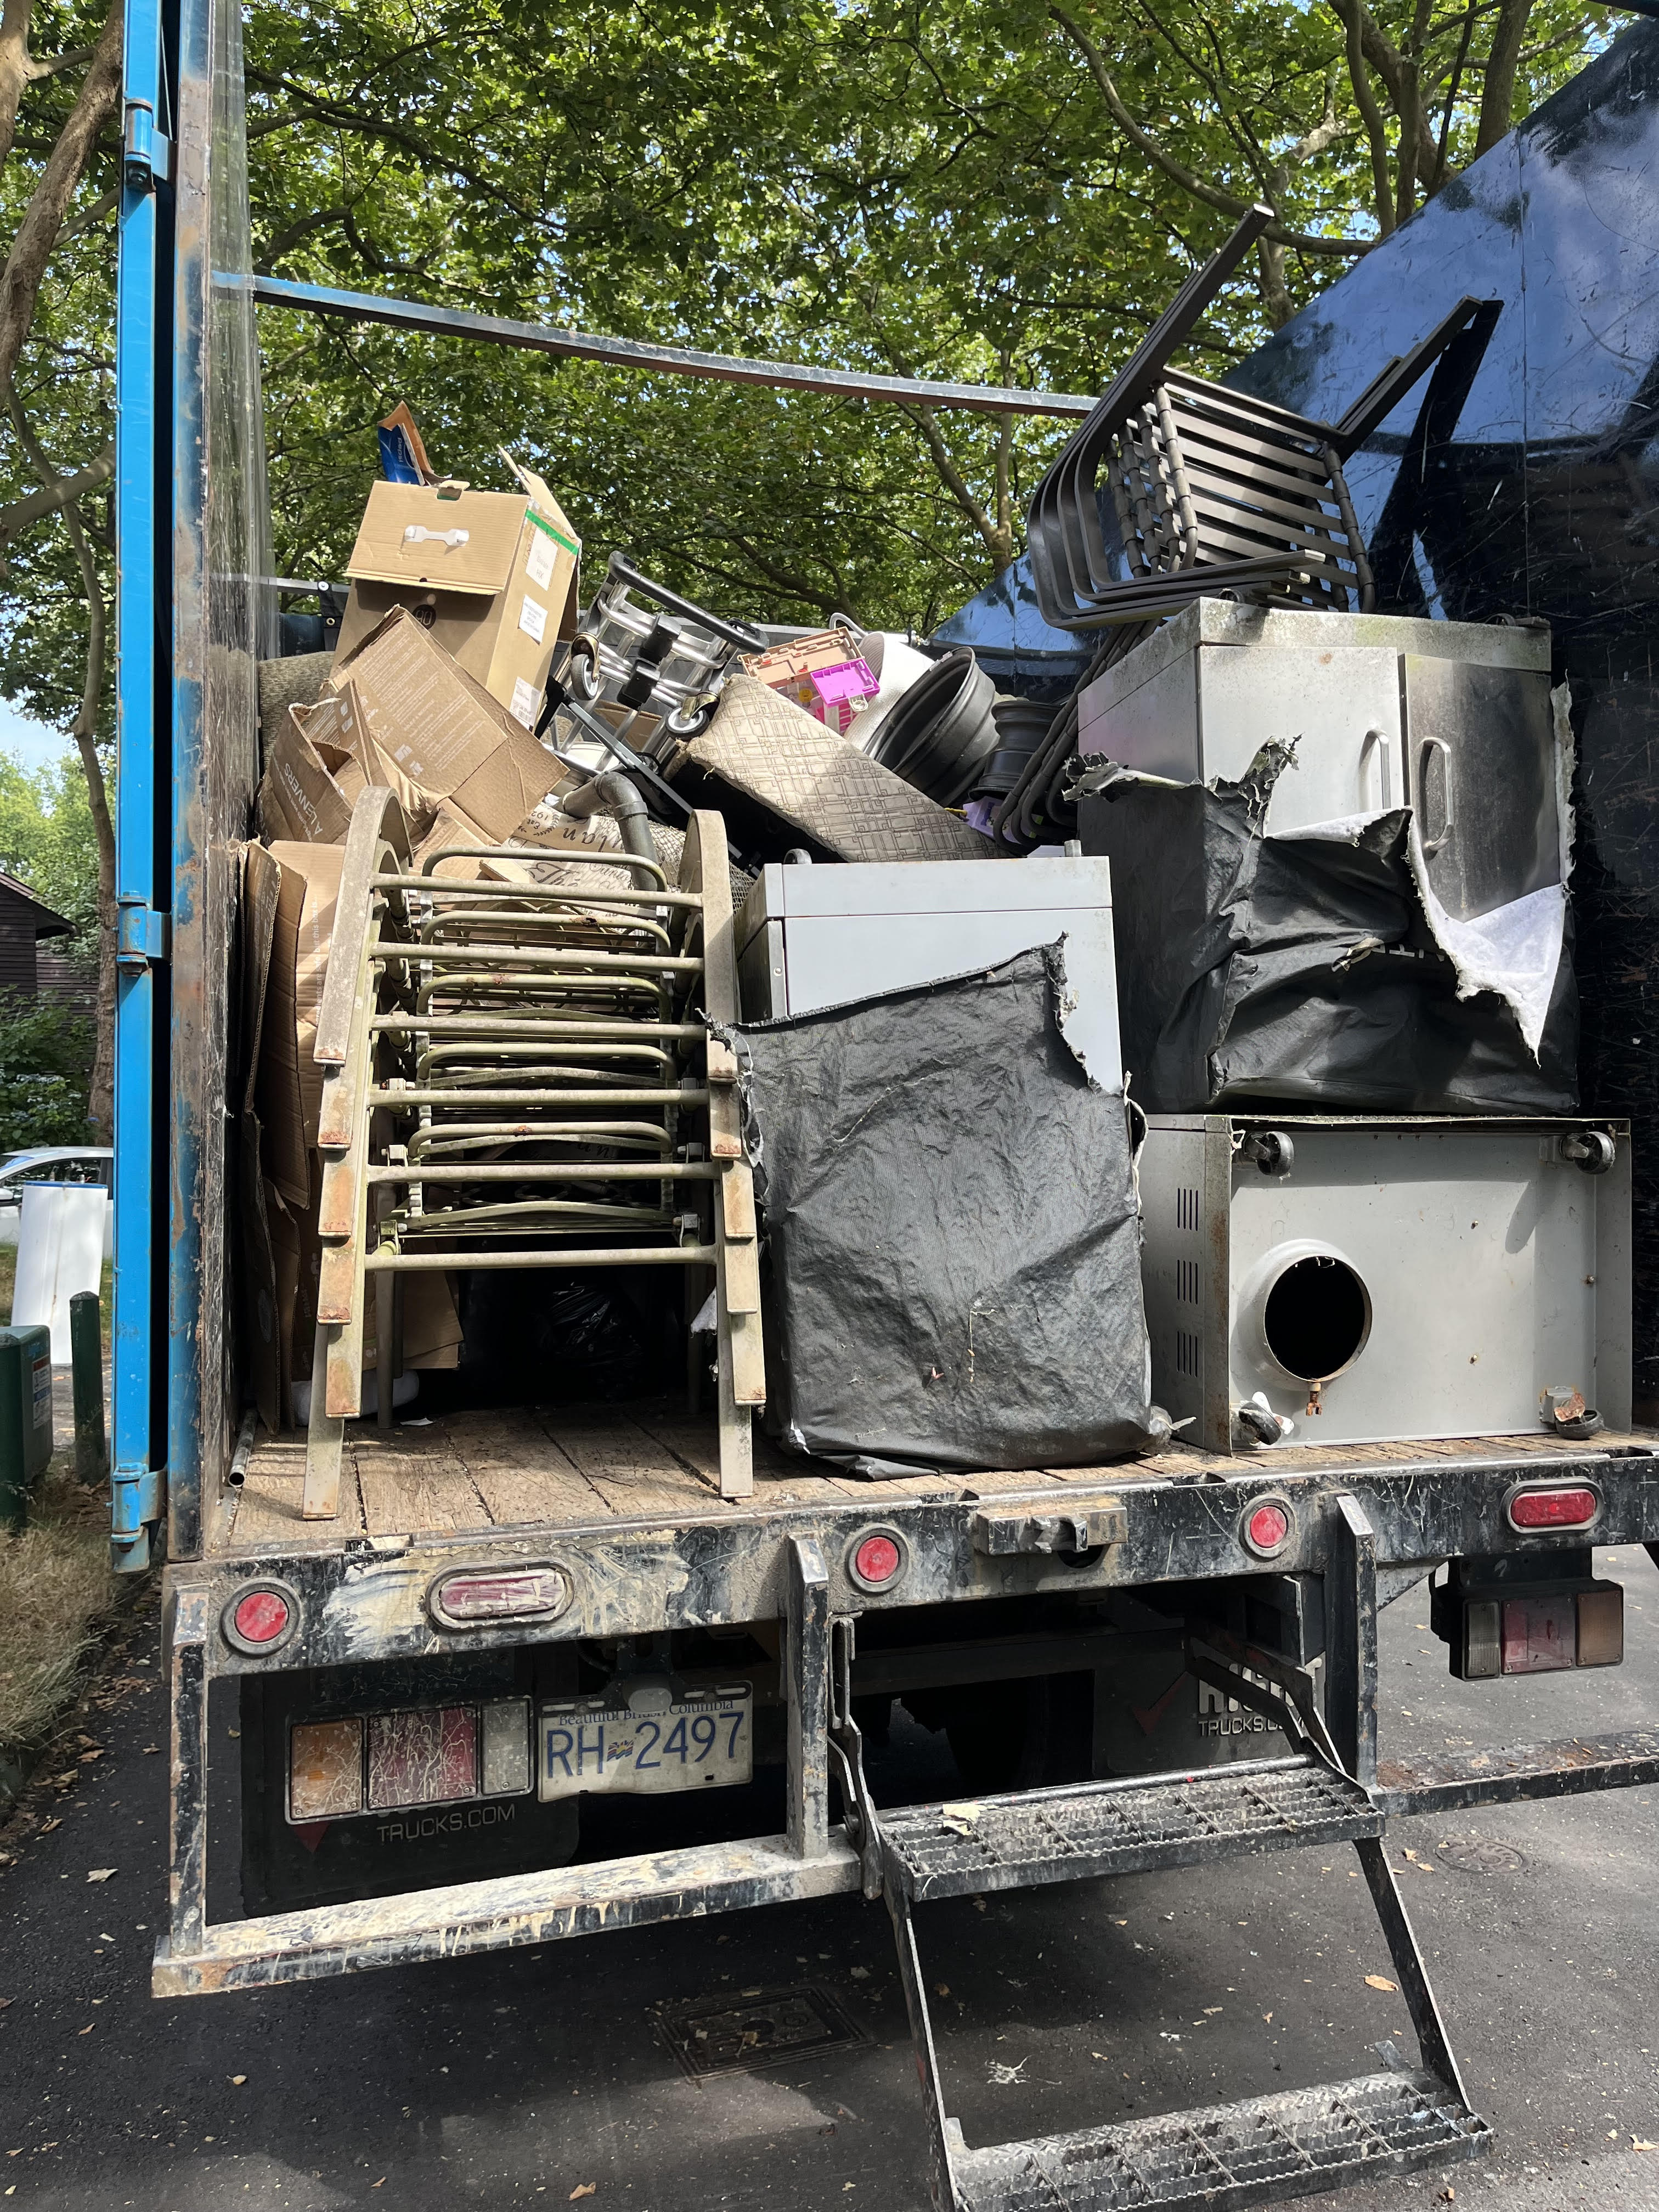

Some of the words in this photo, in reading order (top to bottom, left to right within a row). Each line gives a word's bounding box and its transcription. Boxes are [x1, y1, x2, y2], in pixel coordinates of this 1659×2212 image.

[531, 810, 549, 821] 192
[669, 1700, 734, 1715] Columbia
[547, 1725, 604, 1779] RH
[635, 1711, 744, 1770] 2497
[376, 1803, 516, 1842] TRUCKS.COM
